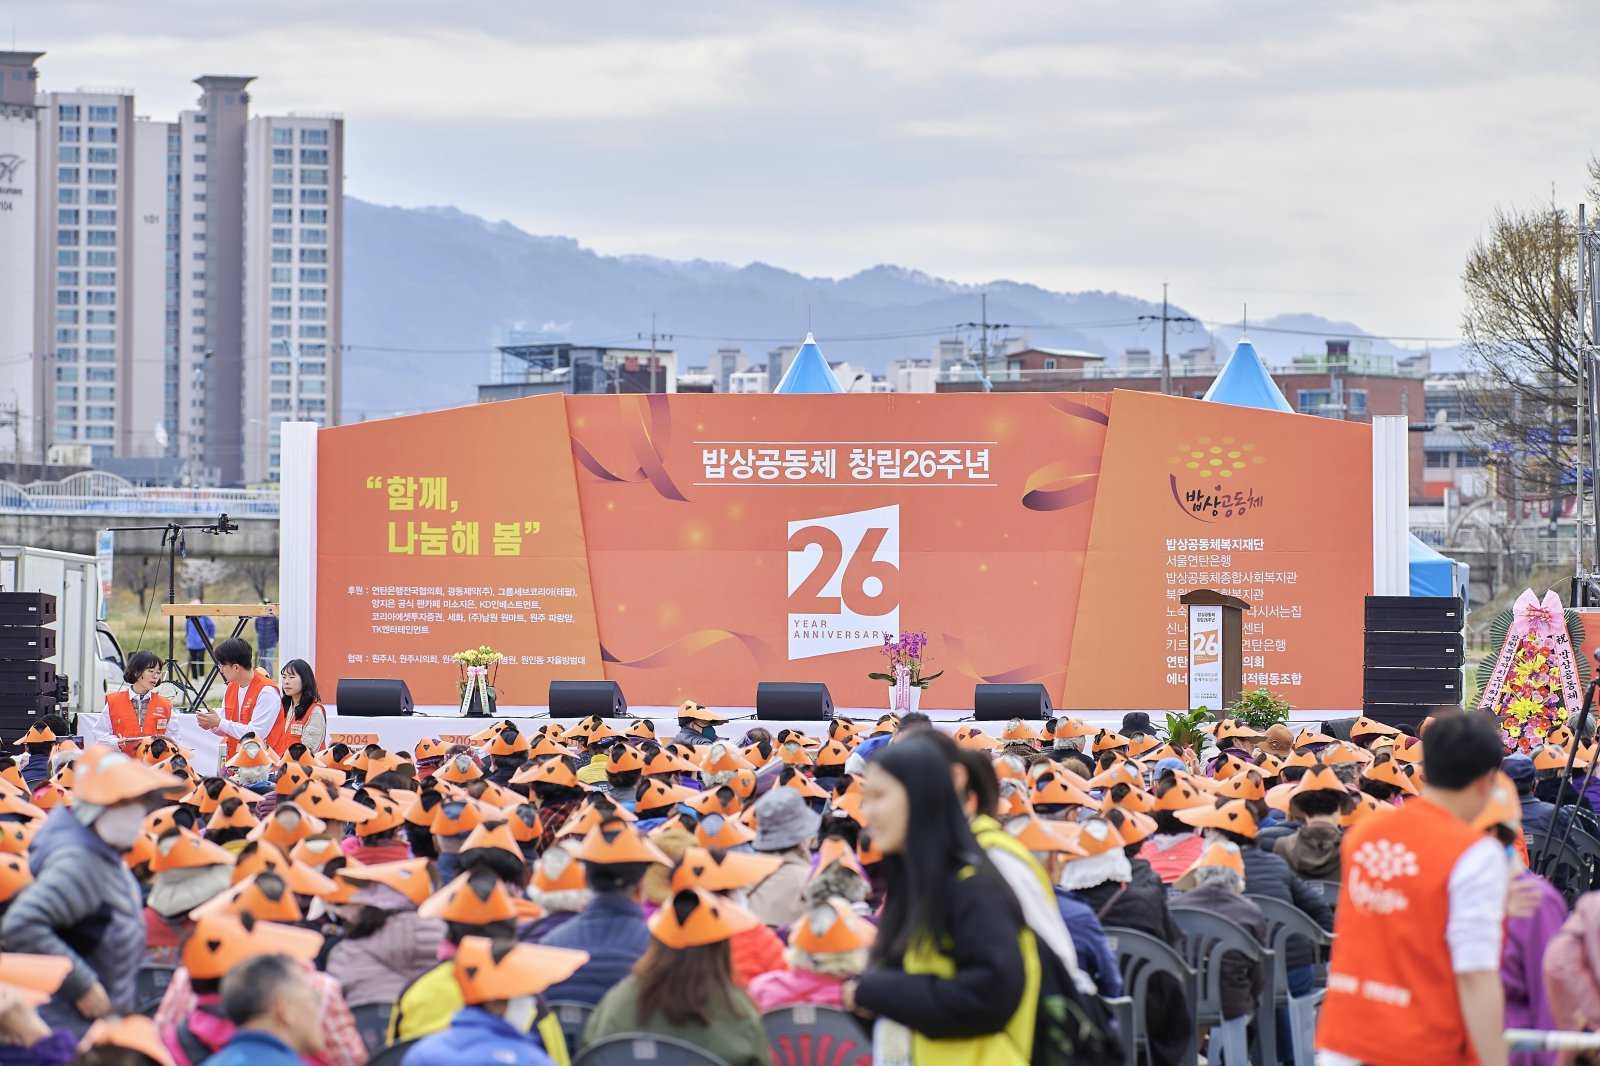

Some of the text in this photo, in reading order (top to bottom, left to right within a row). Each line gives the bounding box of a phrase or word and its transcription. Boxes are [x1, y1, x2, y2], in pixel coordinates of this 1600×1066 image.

[703, 449, 989, 479] 밥상공동체 창립26주년
[1186, 488, 1263, 518] 밥상공동체
[389, 521, 540, 555] 나눔해 봄”
[1166, 538, 1264, 551] 밥상공동체복지재단
[1167, 555, 1230, 567] 서울연탄은행
[788, 526, 900, 616] 26
[1167, 572, 1296, 584] 밥상공동체종합사회복지관
[348, 586, 362, 594] 후원
[372, 599, 395, 608] 양지은
[398, 600, 413, 608] 공식
[530, 614, 546, 622] 원주
[793, 618, 829, 628] YEAR
[793, 629, 890, 640] ANNIVERSARY
[1556, 634, 1569, 644] 祝
[1194, 633, 1218, 656] 26
[348, 655, 362, 663] 협력
[372, 655, 396, 663] 원주시,
[400, 655, 439, 663] 원주시의회,
[522, 656, 544, 664] 원인동
[1558, 650, 1578, 700] 밥상공동체
[340, 734, 368, 745] 2004
